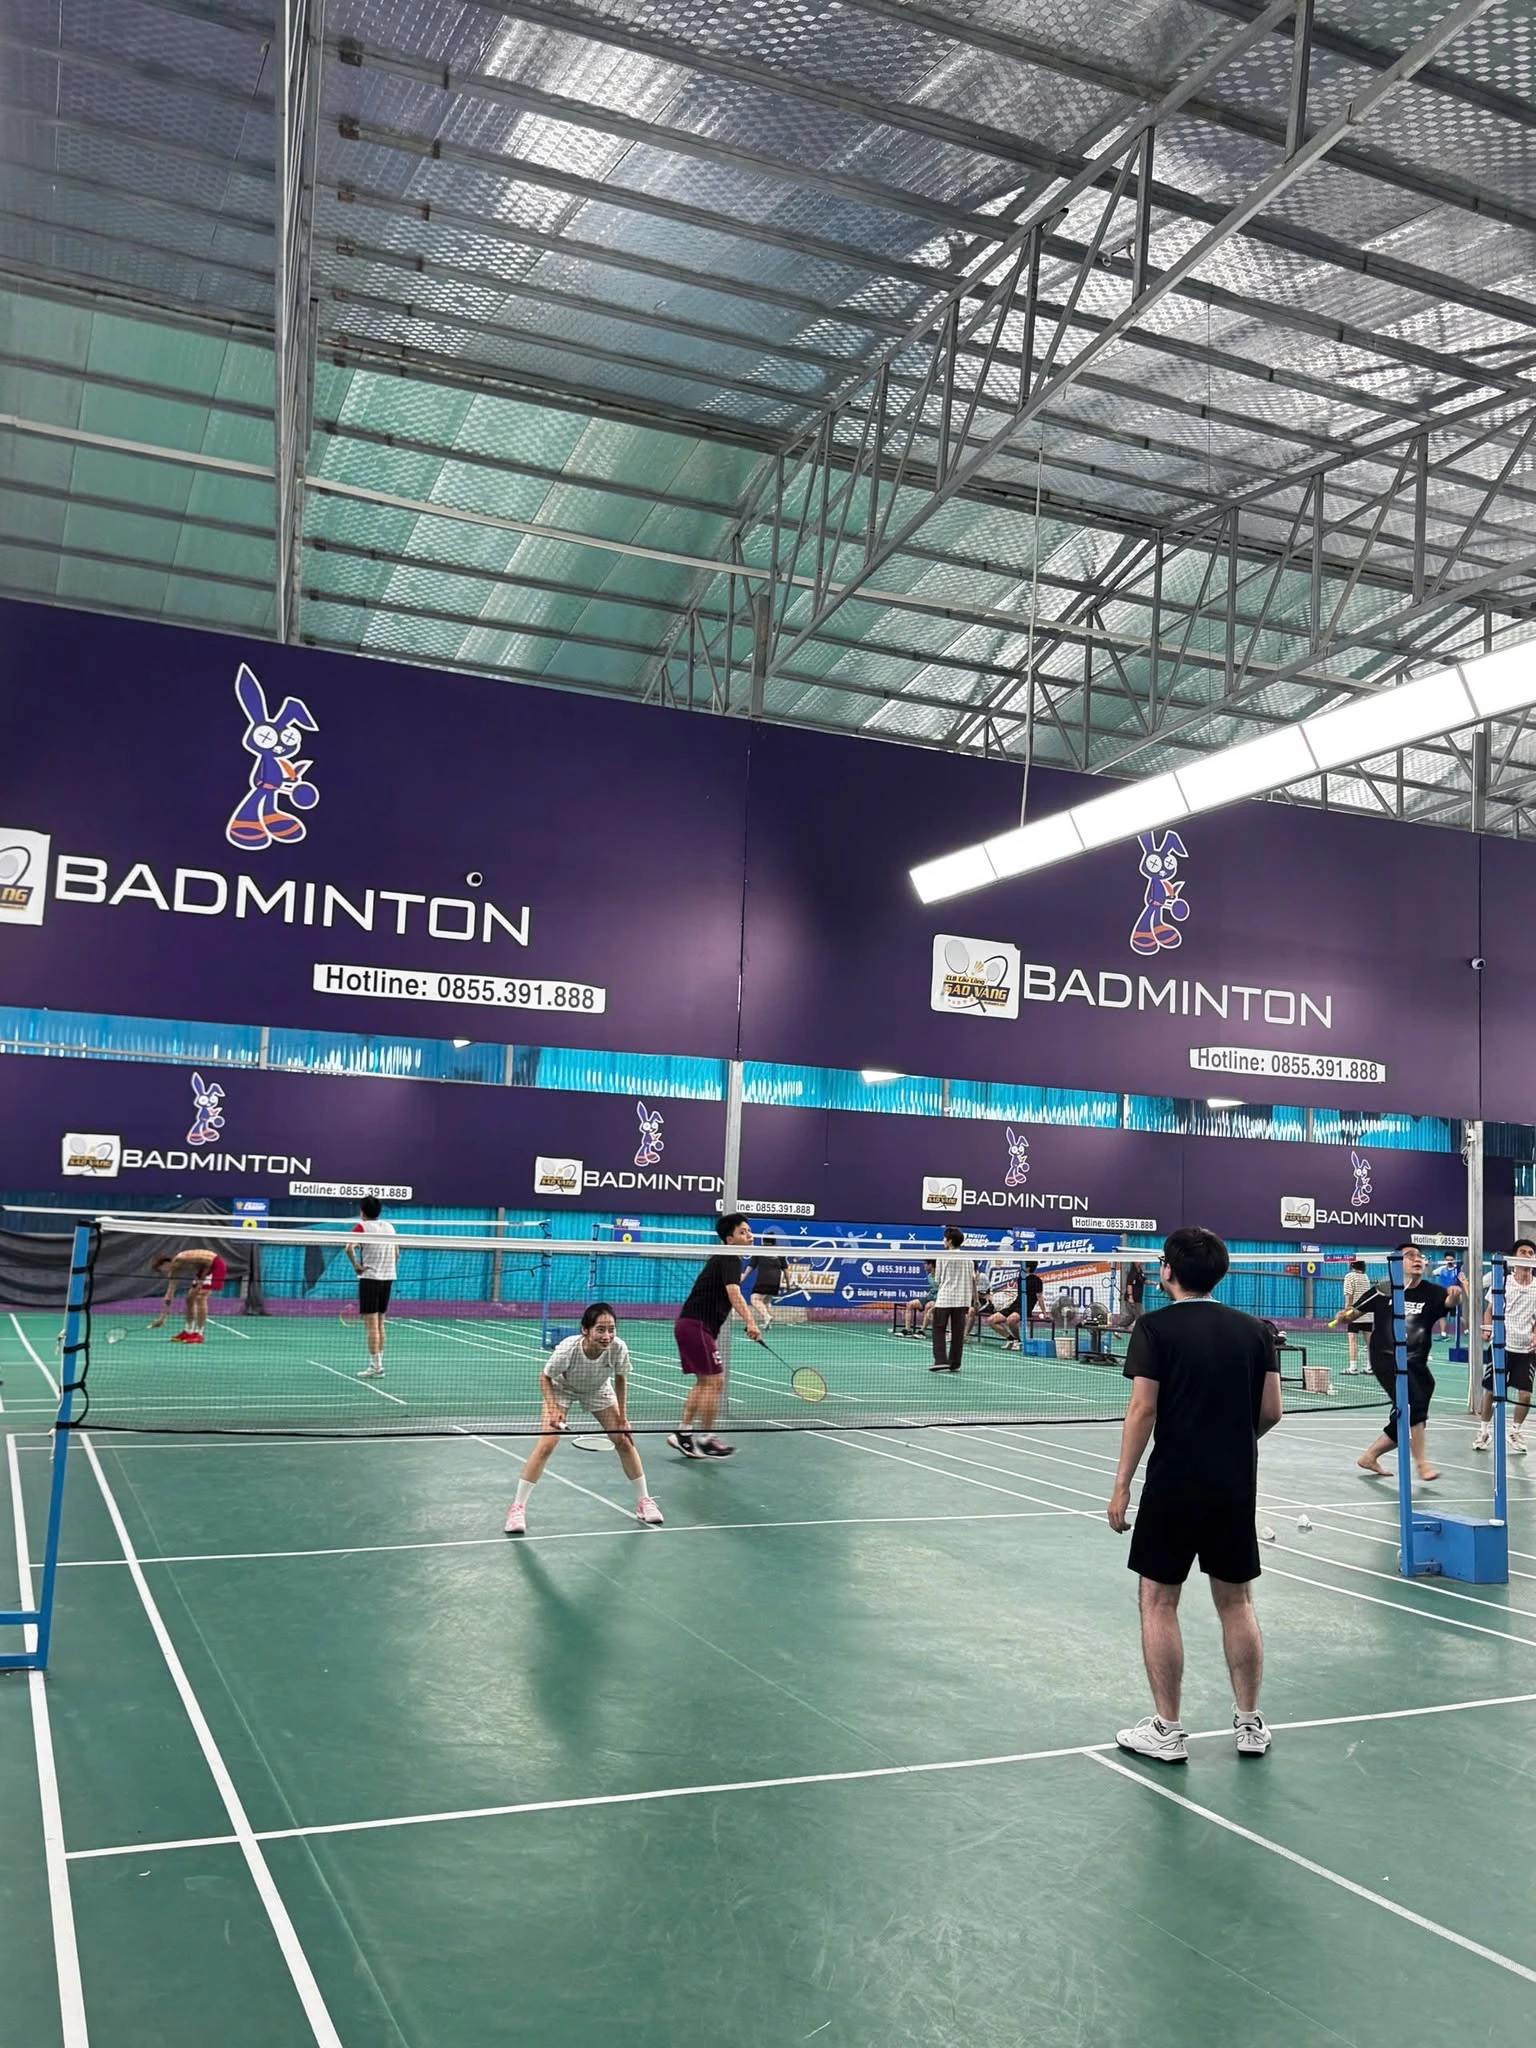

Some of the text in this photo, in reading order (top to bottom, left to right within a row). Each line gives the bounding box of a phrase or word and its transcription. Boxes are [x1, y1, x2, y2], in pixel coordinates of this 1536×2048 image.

[56, 854, 530, 946] BADMINTON
[326, 966, 594, 1009] Hotline: 0855.391.888
[944, 983, 971, 997] SAO
[1023, 963, 1333, 1029] BADMINTON
[1198, 1049, 1378, 1081] Hotline: 0855.391.888
[121, 1149, 312, 1176] BADMINTON
[293, 1183, 408, 1198] Hotline: 0855.391.888
[964, 1190, 1088, 1211] BADMINTON
[755, 1202, 811, 1215] 0855.391.888
[1075, 1218, 1154, 1230] Hotline: 0855.391.888
[1316, 1209, 1424, 1229] BADMINTON
[1056, 1239, 1091, 1250] Water
[1413, 1236, 1438, 1245] Hotline
